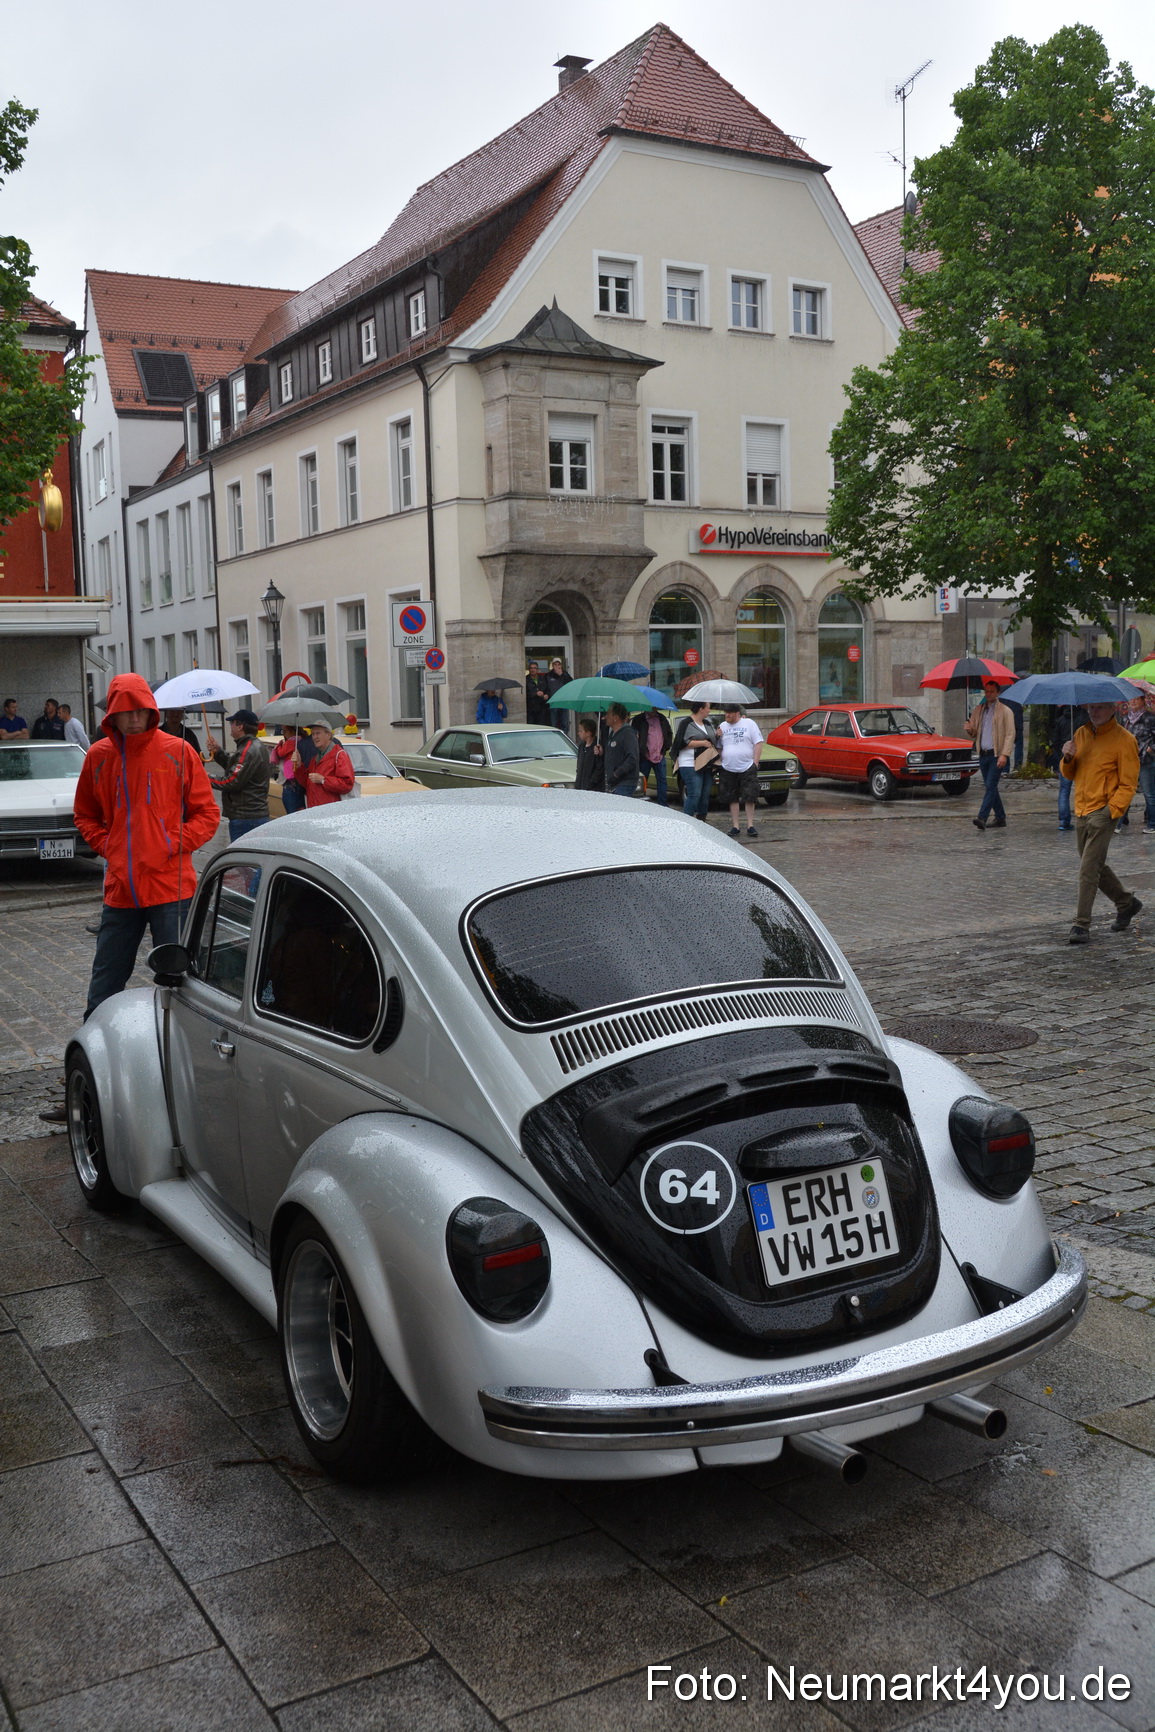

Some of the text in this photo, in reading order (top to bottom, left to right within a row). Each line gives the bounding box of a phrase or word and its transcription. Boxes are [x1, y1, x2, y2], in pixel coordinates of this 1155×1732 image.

[718, 525, 834, 549] HypoVereinsbank
[41, 849, 72, 858] SW 611H
[50, 841, 56, 849] N
[658, 1168, 720, 1205] 64
[782, 1172, 854, 1226] ERH
[759, 1213, 769, 1226] D
[767, 1210, 891, 1276] VW 15H
